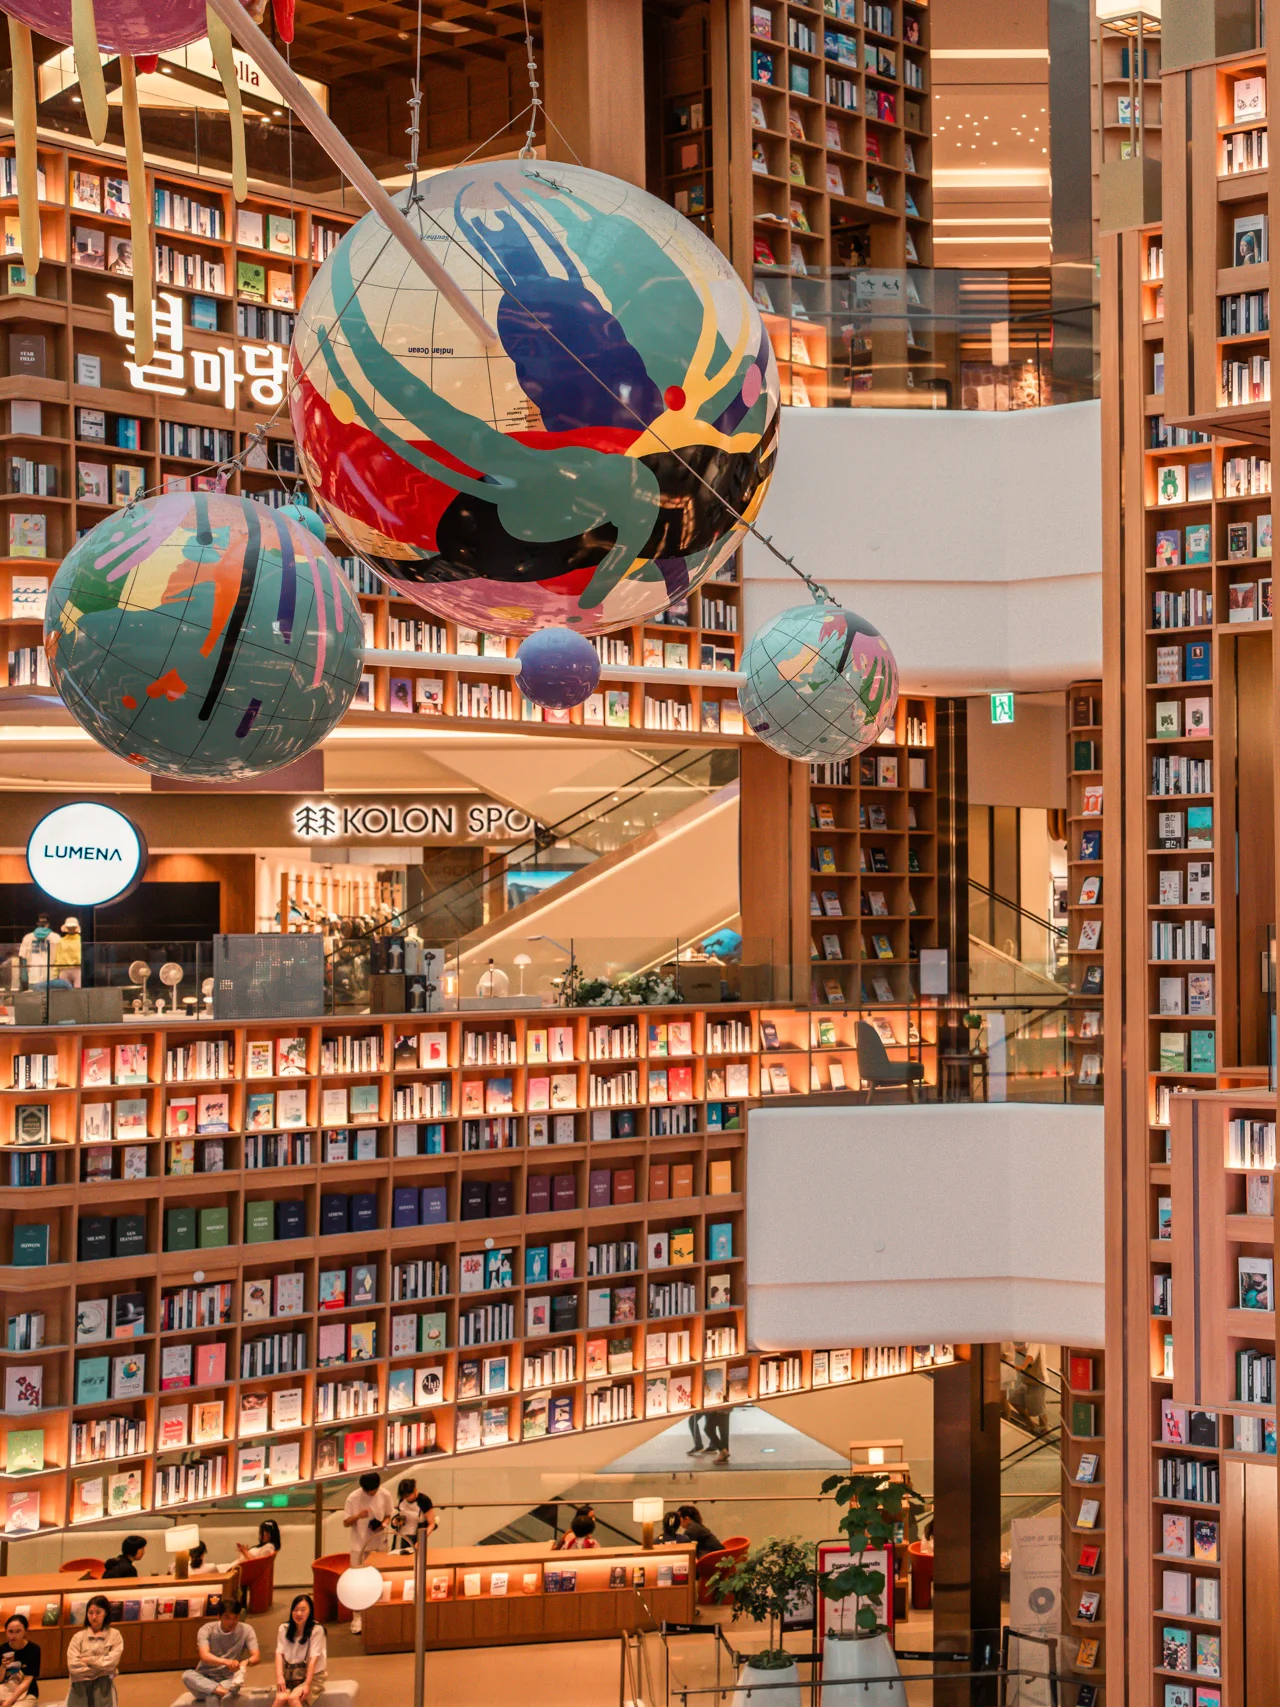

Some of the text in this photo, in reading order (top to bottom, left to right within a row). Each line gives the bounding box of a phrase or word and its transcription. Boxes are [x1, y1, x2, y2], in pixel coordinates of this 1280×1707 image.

[408, 347, 454, 356] Indian Ocean
[343, 807, 453, 833] KOLON
[1165, 814, 1176, 822] 공간
[831, 1561, 856, 1569] Popular
